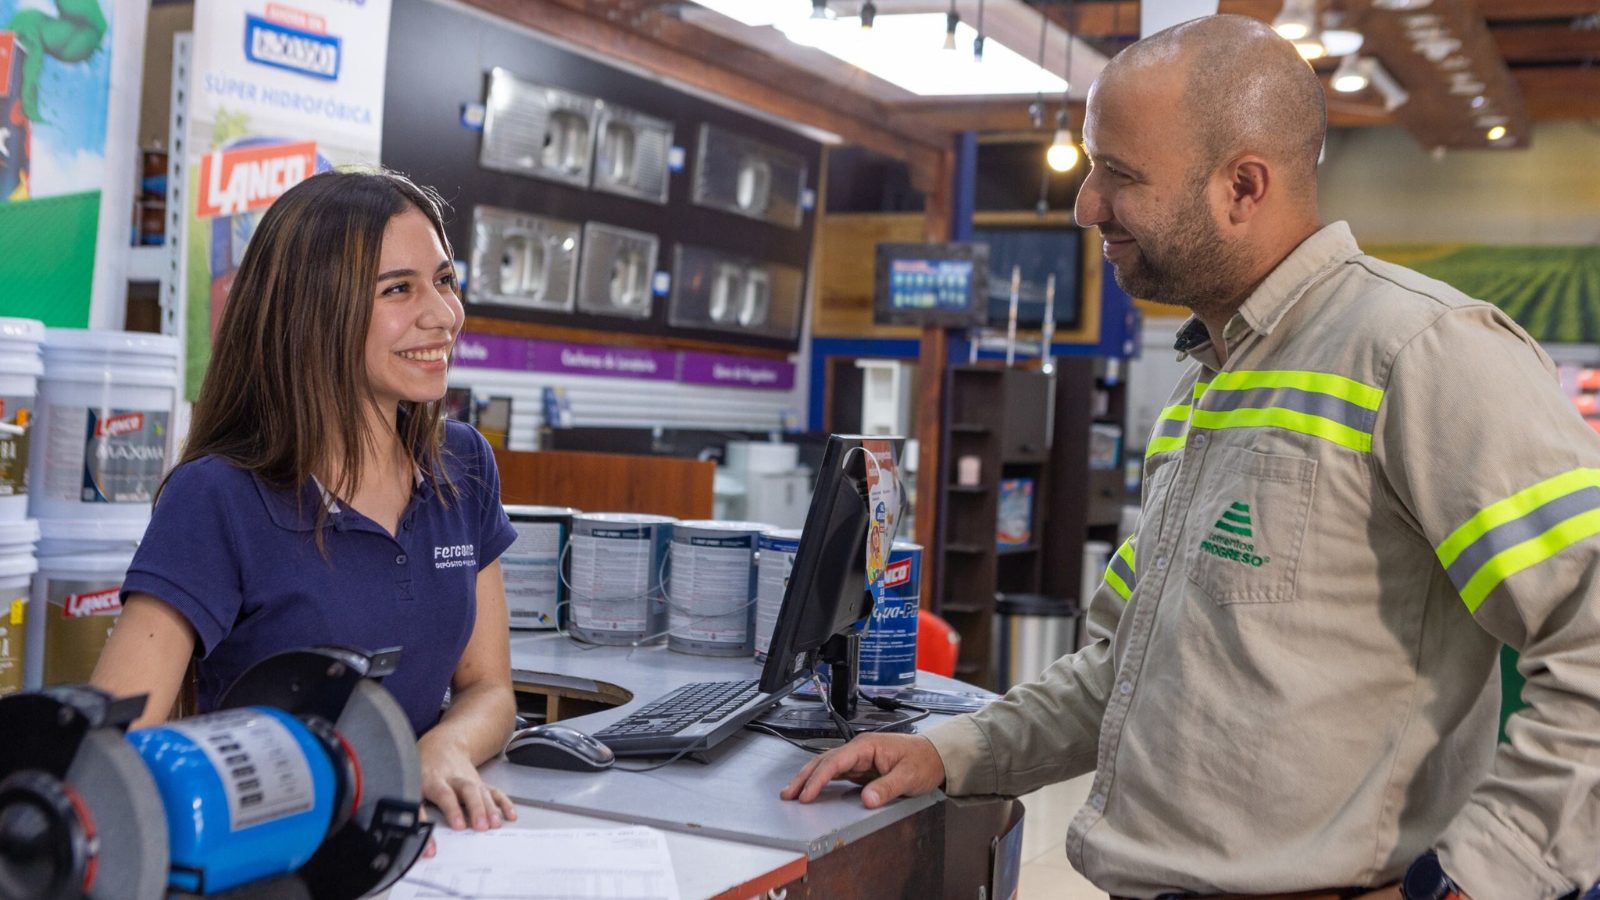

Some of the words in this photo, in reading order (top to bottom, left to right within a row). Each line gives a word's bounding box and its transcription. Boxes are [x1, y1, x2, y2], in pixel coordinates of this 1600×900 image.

[204, 71, 257, 100] SÚPER
[208, 150, 305, 214] LANCO
[884, 565, 909, 583] NCO
